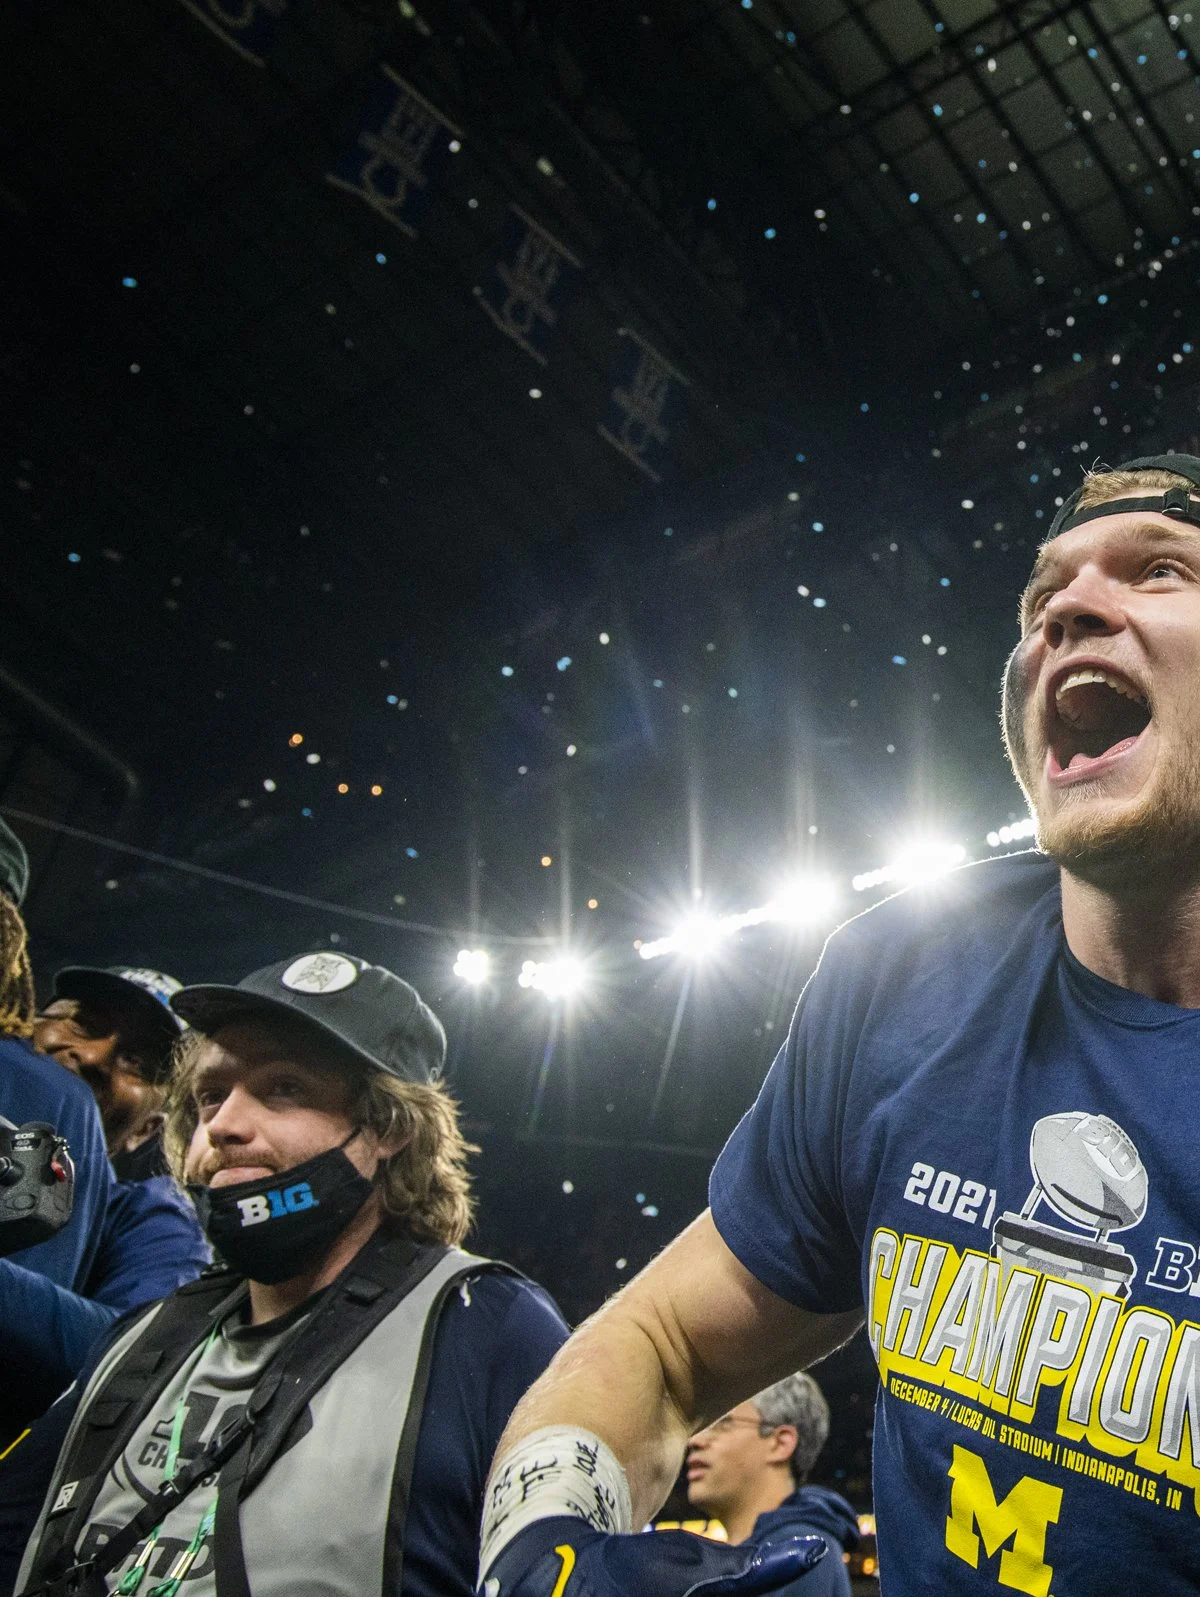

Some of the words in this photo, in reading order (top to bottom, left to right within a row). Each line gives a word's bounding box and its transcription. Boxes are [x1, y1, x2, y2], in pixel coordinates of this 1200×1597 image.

[903, 1161, 997, 1229] 2021
[890, 1377, 941, 1413] DECEMBER
[941, 1399, 950, 1416] 4
[951, 1403, 983, 1431] LUCAS
[981, 1416, 996, 1439] OIL
[999, 1424, 1054, 1461] STADIUM
[1062, 1448, 1160, 1505] INDIANAPOLIS,
[1165, 1487, 1183, 1511] IN
[945, 1443, 1064, 1597] M
